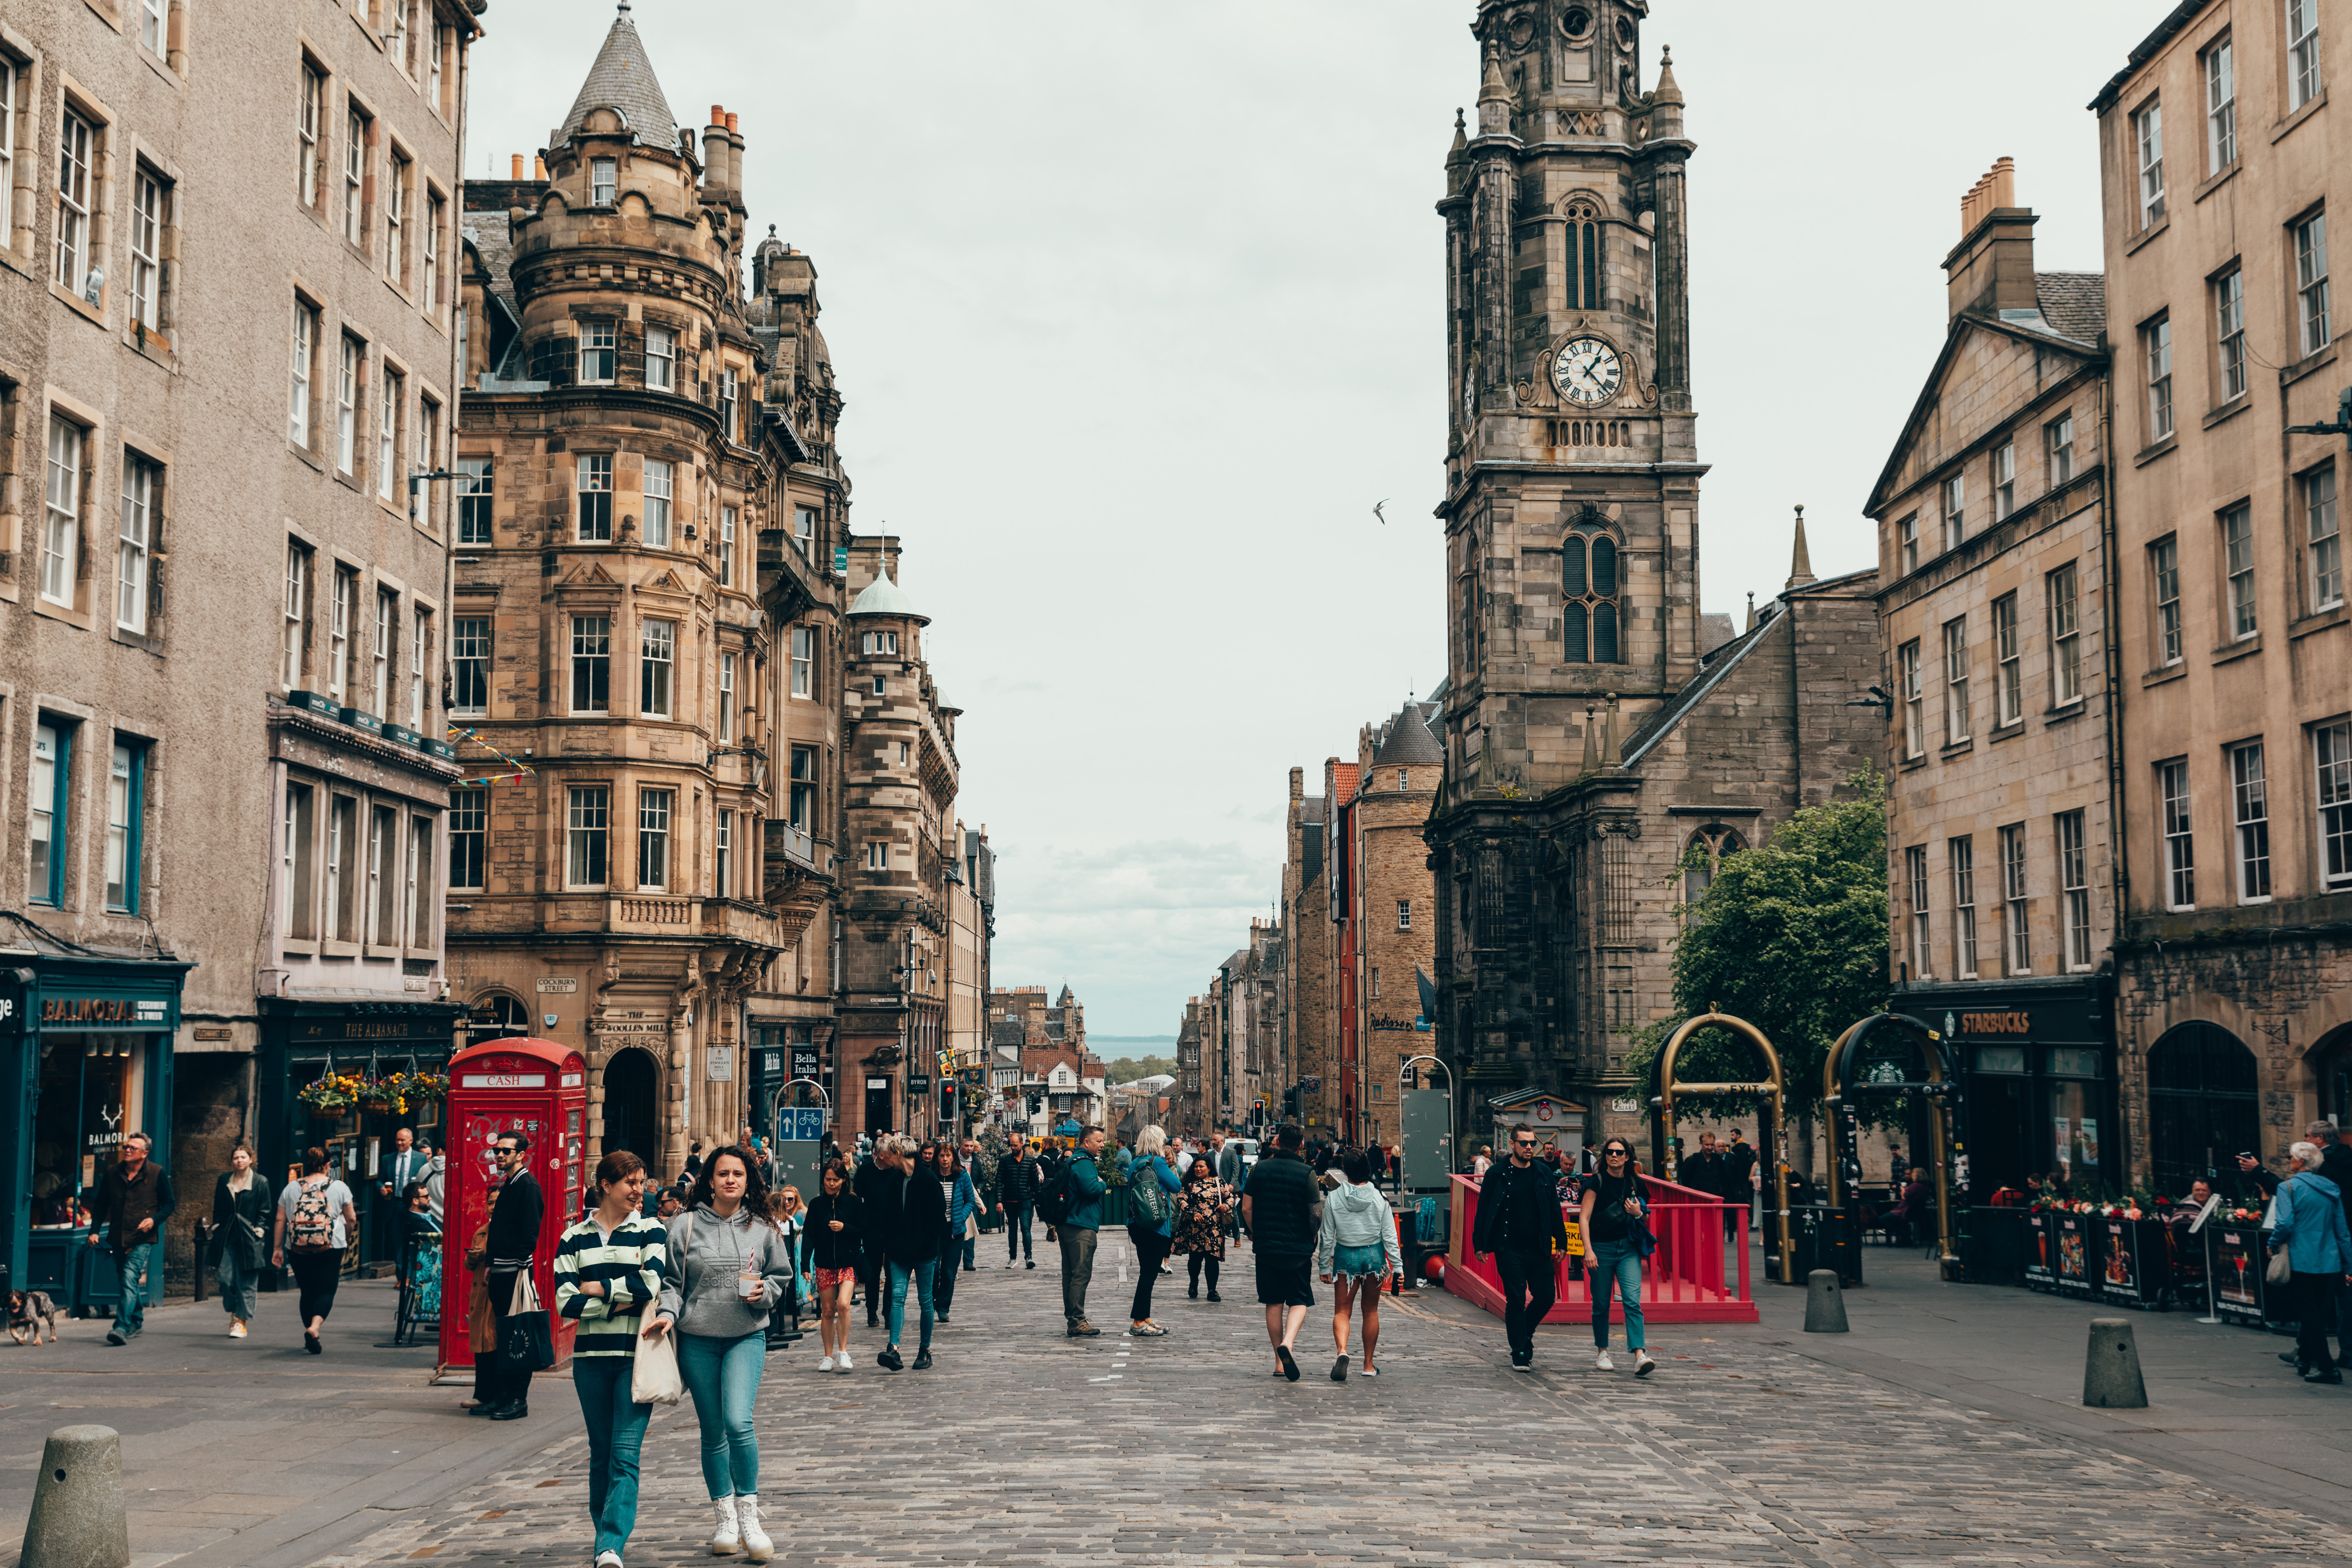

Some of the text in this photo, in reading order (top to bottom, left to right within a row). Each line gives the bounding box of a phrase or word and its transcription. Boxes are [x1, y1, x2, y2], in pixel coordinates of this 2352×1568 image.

[43, 999, 137, 1020] BALMORAL
[1370, 1013, 1413, 1032] Radisson
[1962, 1012, 2030, 1033] STARBUCKS
[346, 1023, 408, 1037] THE ALBANACH
[795, 1054, 817, 1063] Bella
[794, 1065, 817, 1073] Italia
[487, 1076, 520, 1085] CASH
[567, 1075, 575, 1085] CSH
[1730, 1085, 1759, 1094] EXIT
[89, 1132, 128, 1145] BALMORA
[1566, 1232, 1580, 1240] RKI
[699, 1274, 739, 1288] adid
